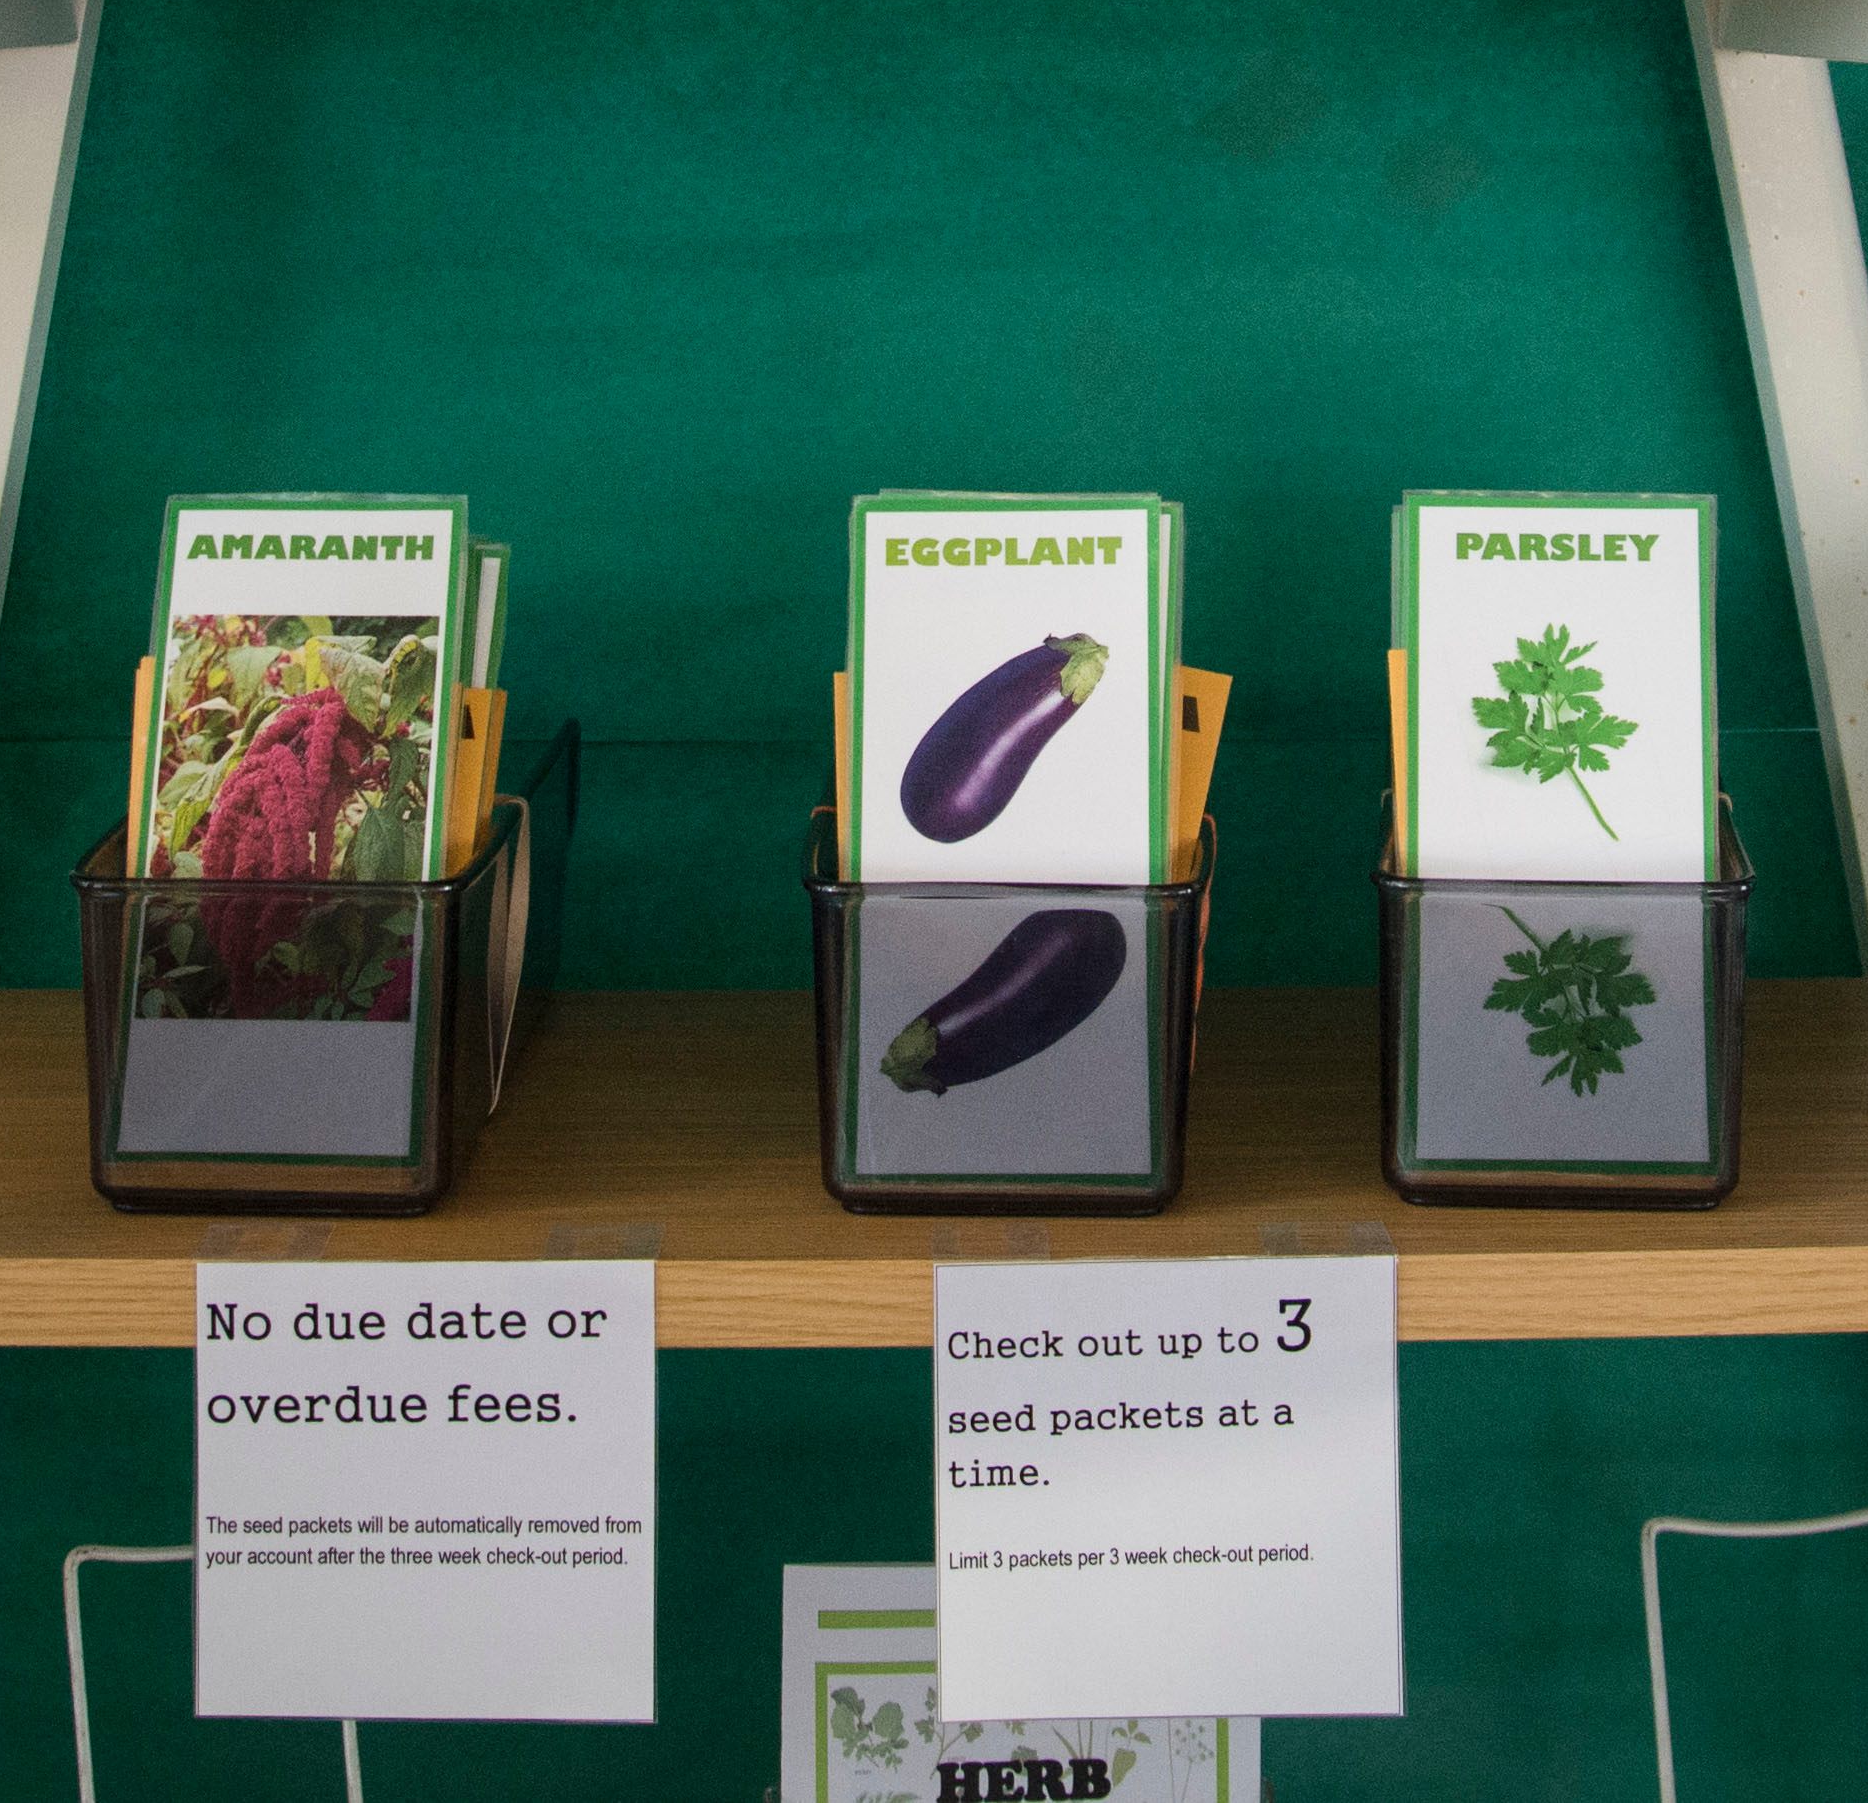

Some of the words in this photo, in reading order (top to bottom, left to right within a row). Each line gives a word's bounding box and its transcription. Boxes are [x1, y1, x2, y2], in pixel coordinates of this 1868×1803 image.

[187, 534, 434, 561] AMARANTH
[885, 536, 1122, 567] EGGPLANT
[1455, 532, 1660, 562] PARSLEY
[207, 1303, 272, 1340] No
[294, 1304, 386, 1340] due
[407, 1303, 527, 1339] date
[548, 1309, 607, 1339] or
[948, 1331, 1064, 1359] Check
[1078, 1329, 1144, 1357] out
[1158, 1332, 1202, 1359] up
[1219, 1327, 1259, 1354] to
[1277, 1298, 1312, 1353] 3
[207, 1386, 427, 1424] overdue
[448, 1384, 577, 1423] fees.
[948, 1404, 1036, 1434] seed
[1050, 1401, 1204, 1436] packets
[1219, 1399, 1259, 1427] at
[1274, 1405, 1294, 1425] a
[949, 1459, 1050, 1488] time.
[206, 1517, 237, 1534] The
[243, 1517, 283, 1534] seed
[289, 1516, 353, 1538] packets
[358, 1516, 384, 1534] will
[389, 1516, 410, 1534] be
[415, 1515, 523, 1538] automatically
[528, 1516, 600, 1534] removed
[605, 1516, 642, 1534] from
[206, 1550, 241, 1569] your
[247, 1549, 313, 1565] account
[318, 1547, 354, 1565] after
[359, 1548, 386, 1565] the
[391, 1548, 433, 1565] three
[438, 1547, 481, 1564] week
[486, 1547, 567, 1565] check-out
[572, 1547, 628, 1569] period.
[949, 1550, 989, 1570] Limit
[993, 1550, 1003, 1568] 3
[1008, 1549, 1073, 1572] packets
[1077, 1550, 1105, 1570] per
[1109, 1548, 1120, 1565] 3
[1124, 1547, 1168, 1565] week
[1173, 1545, 1254, 1564] check-out
[1258, 1544, 1314, 1565] period.
[936, 1759, 1111, 1803] HERB
